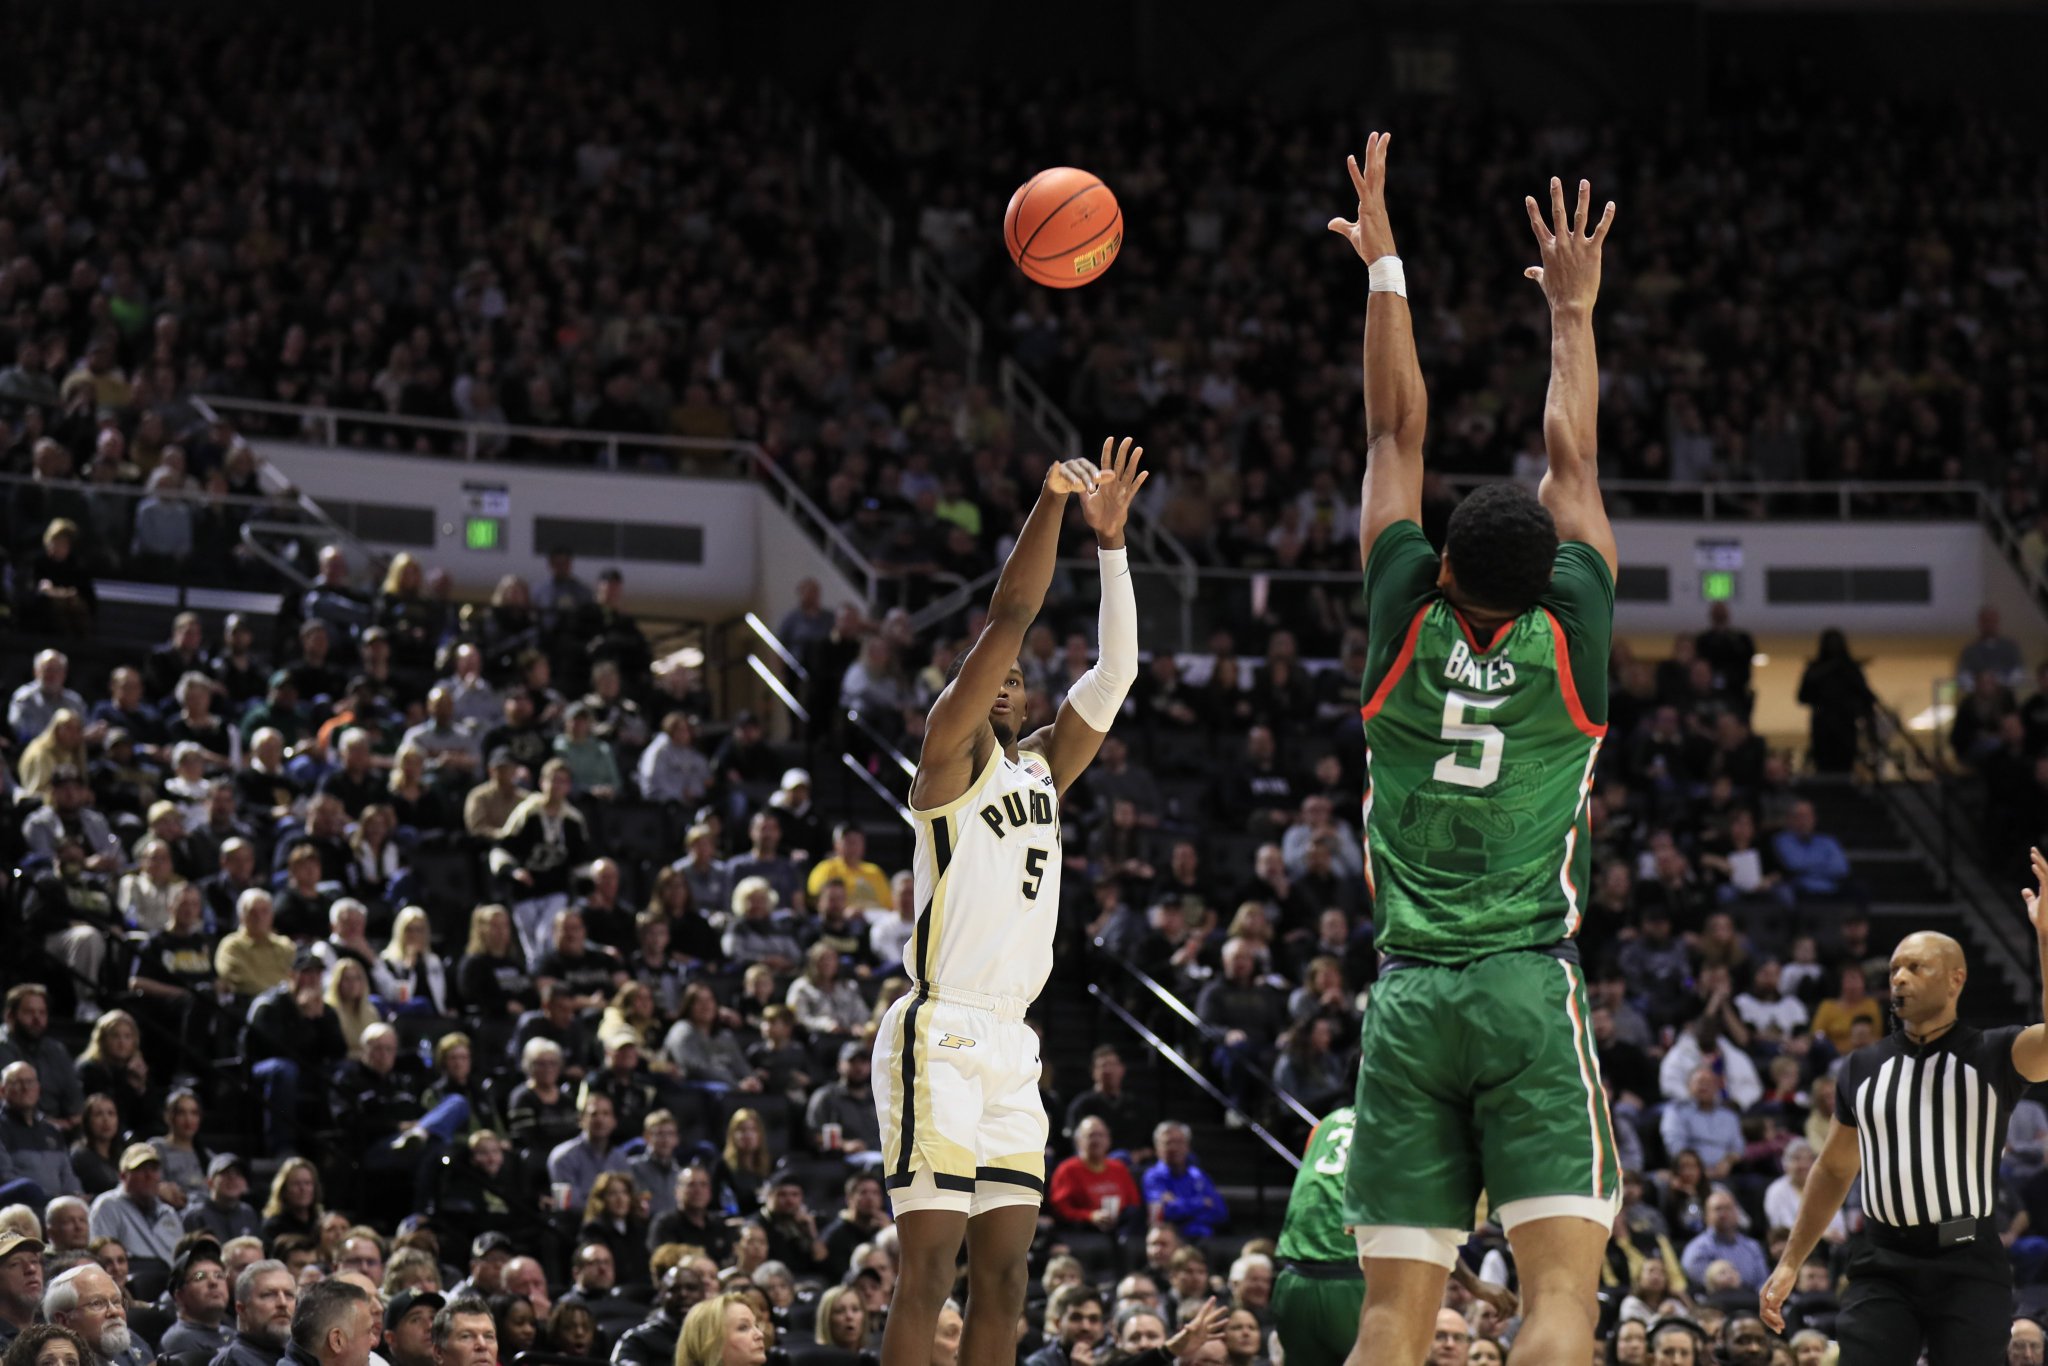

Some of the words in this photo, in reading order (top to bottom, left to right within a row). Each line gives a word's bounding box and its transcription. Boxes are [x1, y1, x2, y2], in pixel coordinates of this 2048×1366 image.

[1432, 689, 1511, 789] 5
[1022, 847, 1049, 901] 5
[1314, 1126, 1354, 1176] 3
